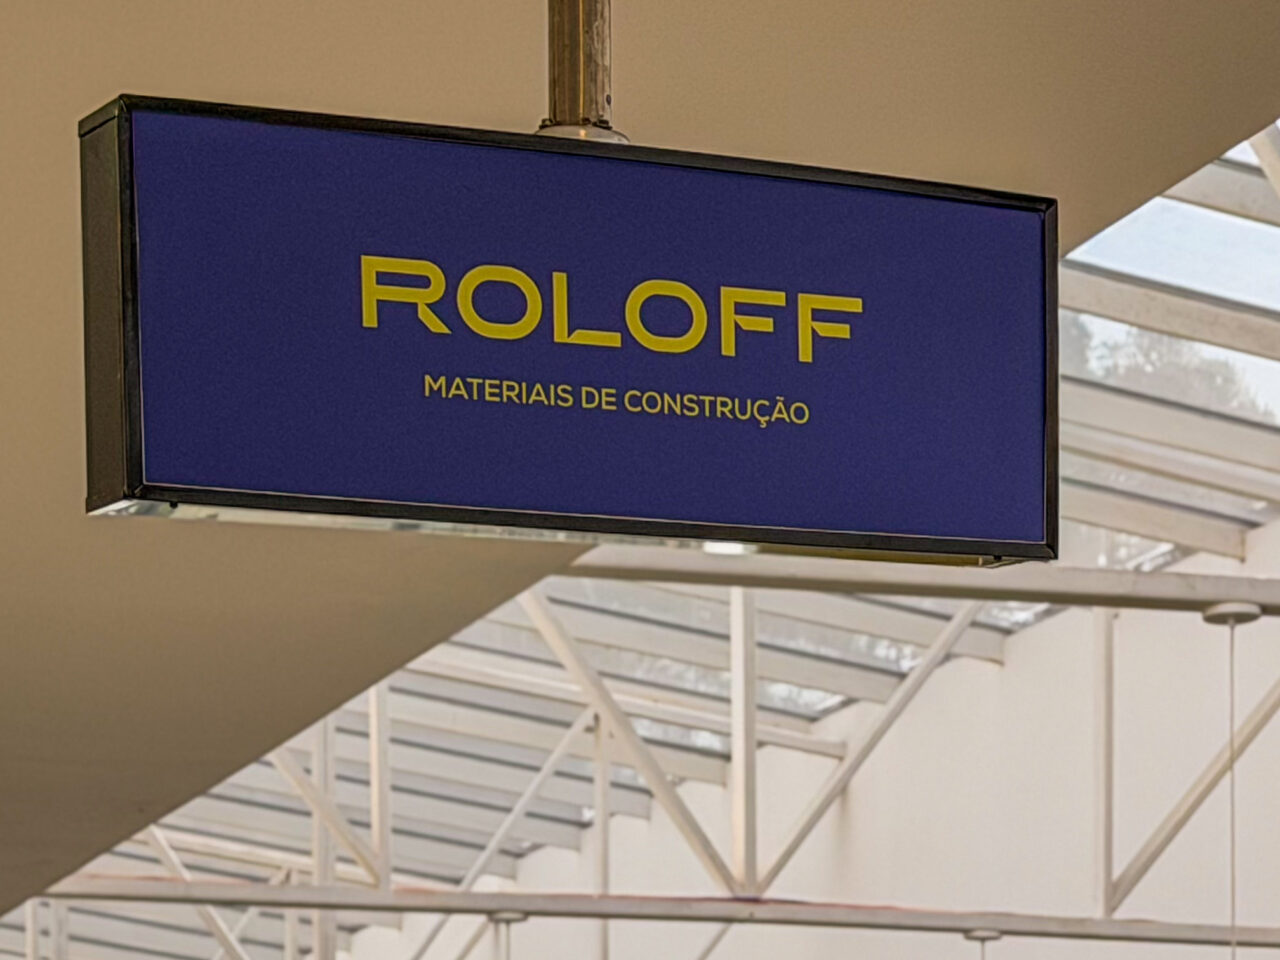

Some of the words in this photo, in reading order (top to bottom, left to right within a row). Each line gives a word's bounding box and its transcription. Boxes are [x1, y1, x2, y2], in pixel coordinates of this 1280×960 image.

[360, 254, 864, 364] ROLOFF
[423, 374, 574, 408] MATERIAIS
[581, 386, 618, 411] DE
[623, 390, 811, 428] CONSTRUÇÃO
